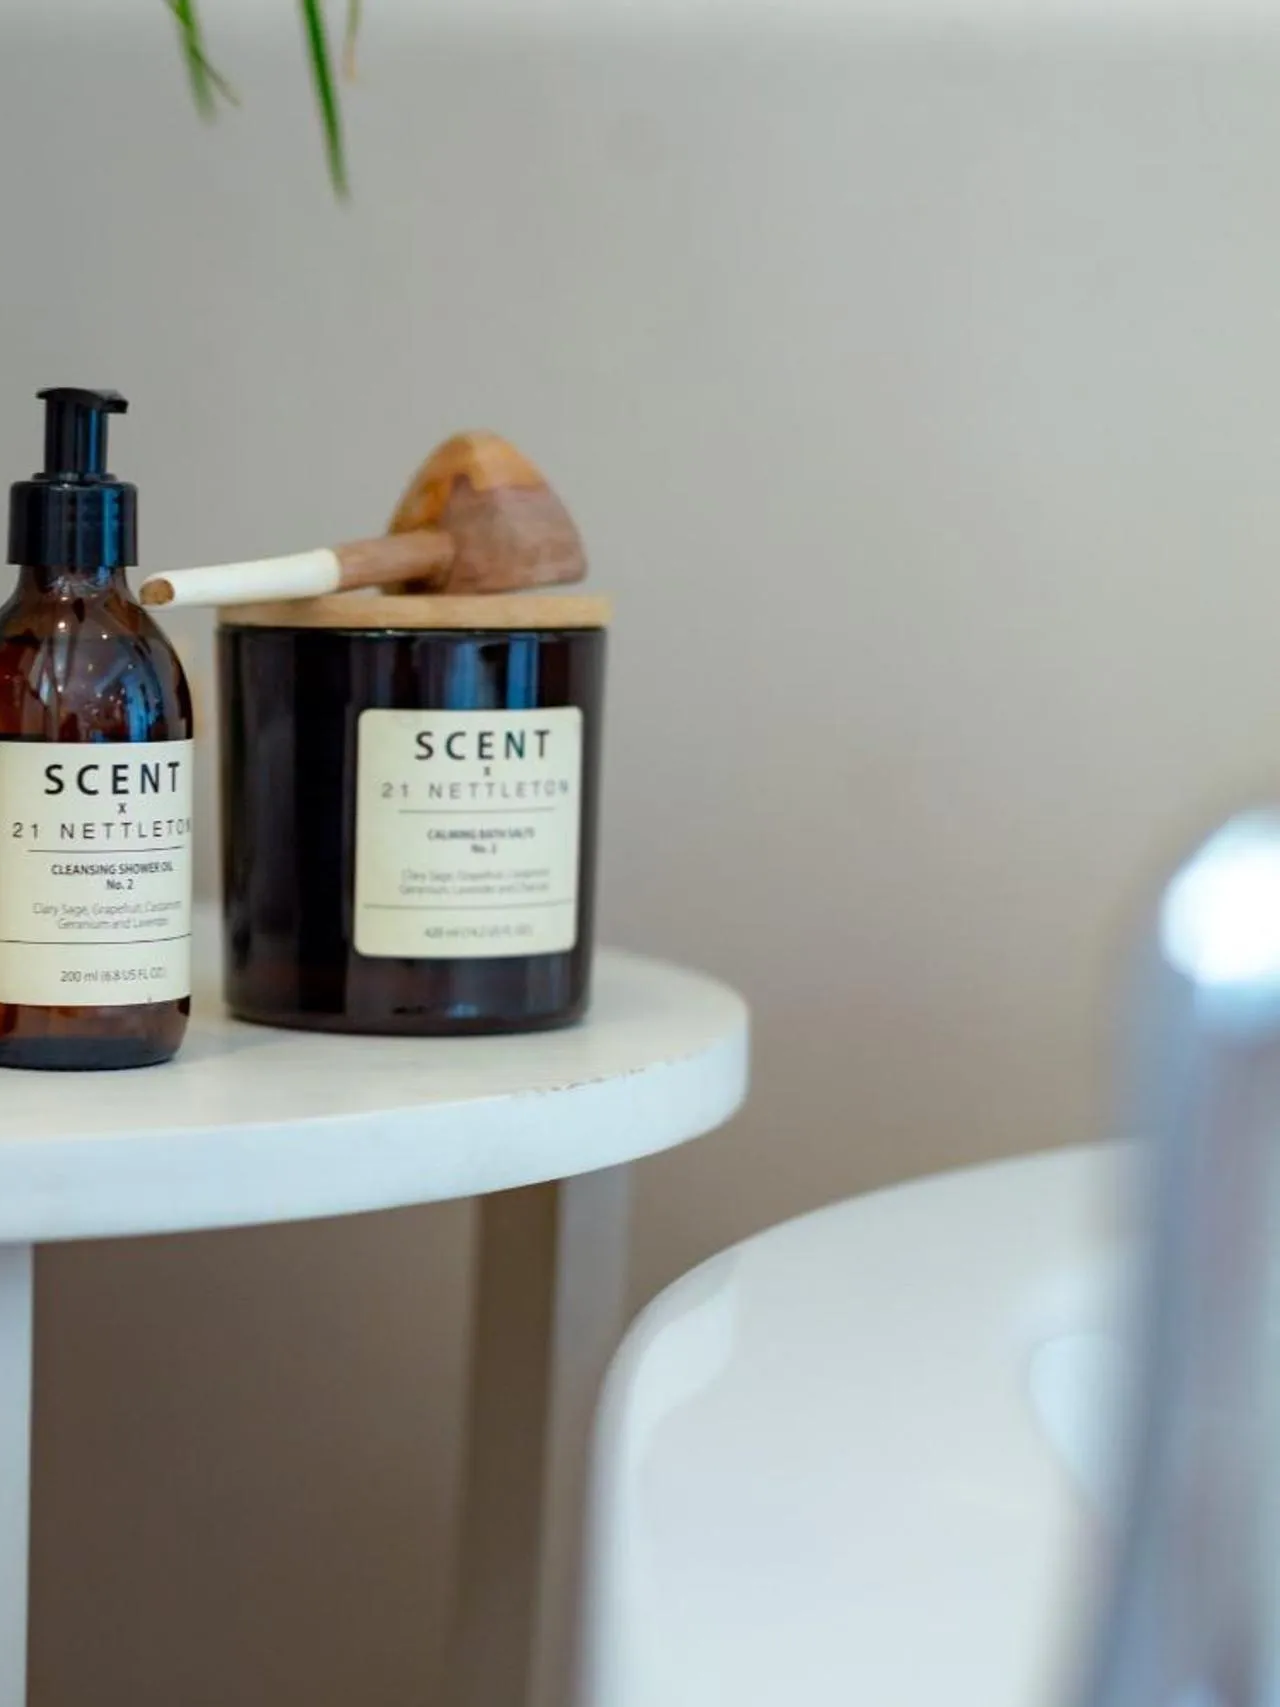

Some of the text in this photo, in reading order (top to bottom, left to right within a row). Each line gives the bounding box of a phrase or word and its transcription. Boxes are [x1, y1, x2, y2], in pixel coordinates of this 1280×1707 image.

[415, 730, 550, 760] SCENT
[44, 762, 180, 795] SCENT
[381, 779, 569, 799] 21 NETTLETON
[12, 822, 39, 839] 21
[51, 863, 117, 876] CLEANSING
[118, 861, 161, 875] SHOWER
[106, 878, 134, 891] No. 2
[60, 970, 82, 983] 200
[83, 969, 98, 982] ml
[122, 968, 136, 981] US
